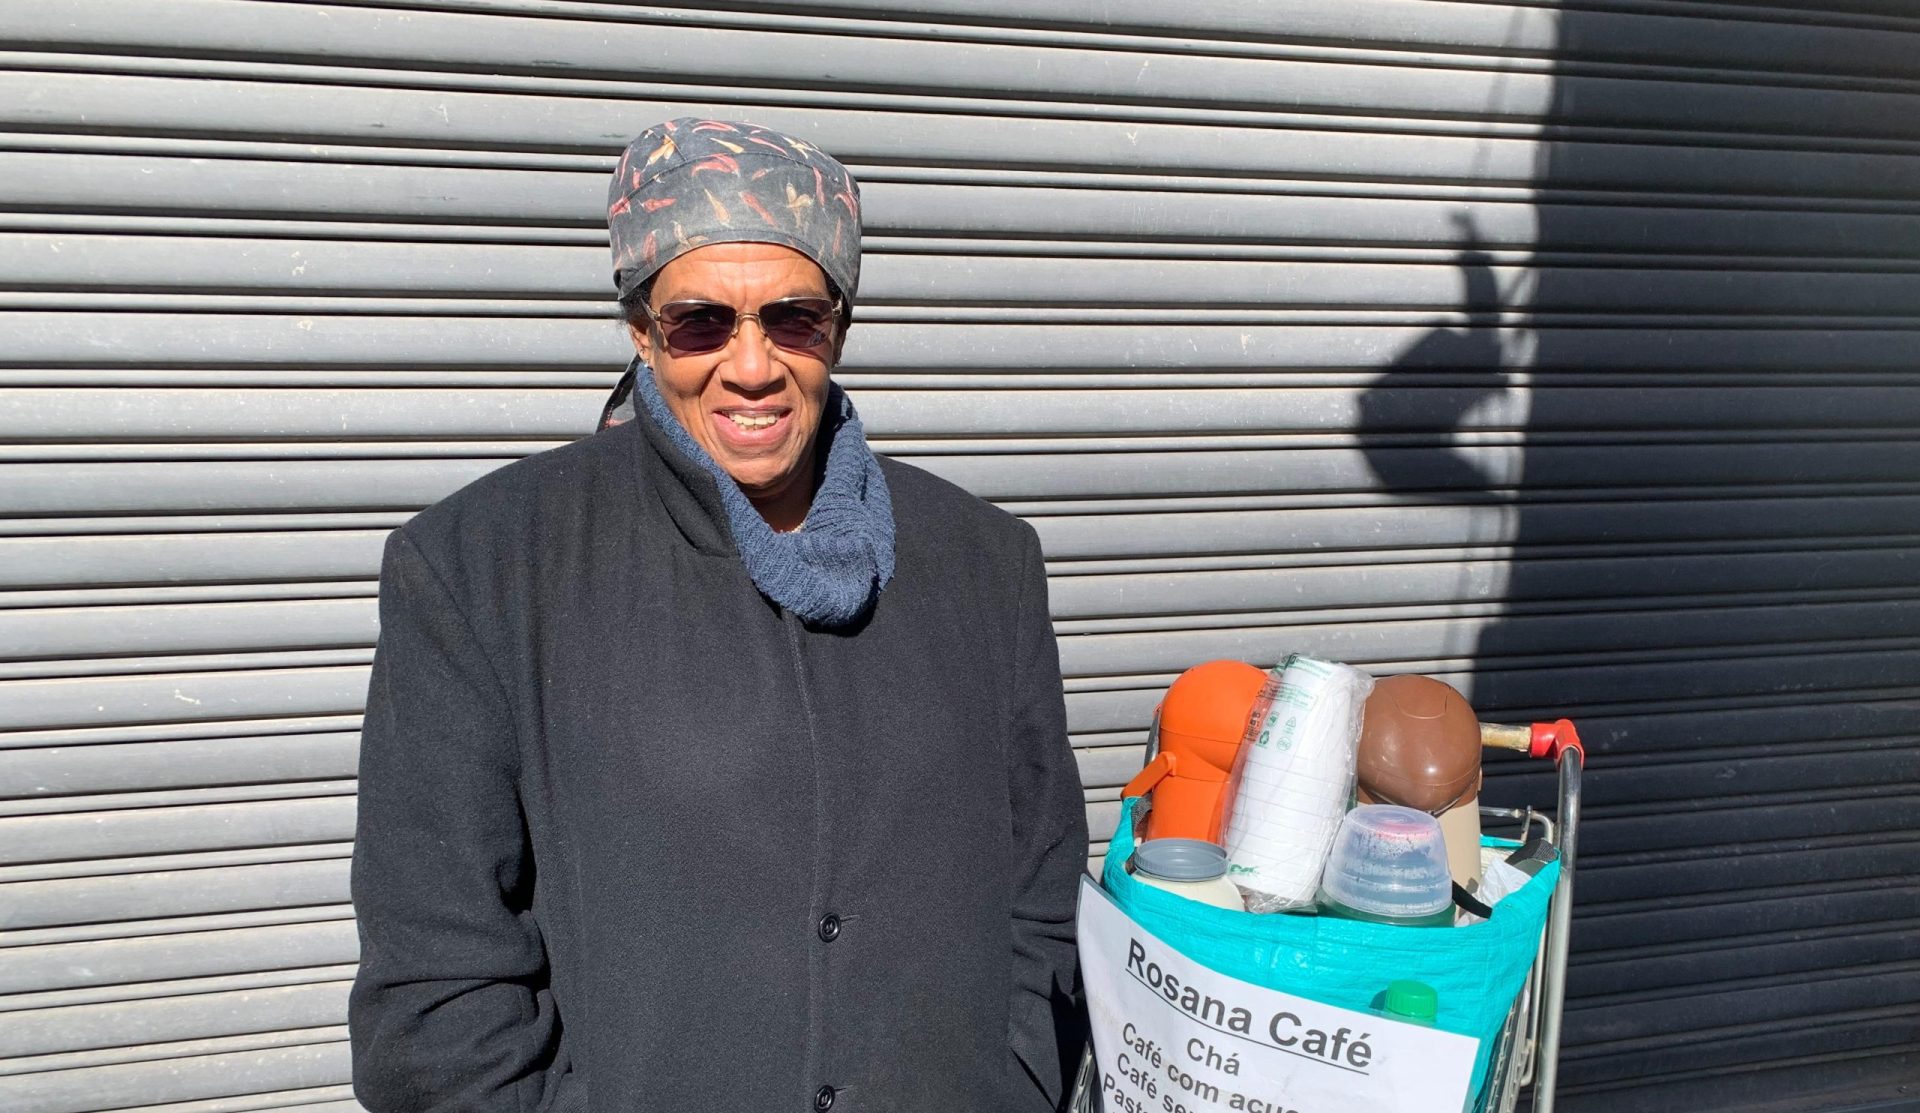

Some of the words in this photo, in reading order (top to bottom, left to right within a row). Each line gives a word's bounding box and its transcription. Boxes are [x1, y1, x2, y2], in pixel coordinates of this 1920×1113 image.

[1127, 938, 1252, 1035] Rosana
[1268, 1012, 1373, 1068] Café
[1117, 1053, 1157, 1099] Café
[1162, 1094, 1194, 1113] se
[1123, 1022, 1162, 1069] Café
[1168, 1064, 1219, 1103] com
[1187, 1038, 1240, 1076] Chá
[1103, 1072, 1149, 1113] Past
